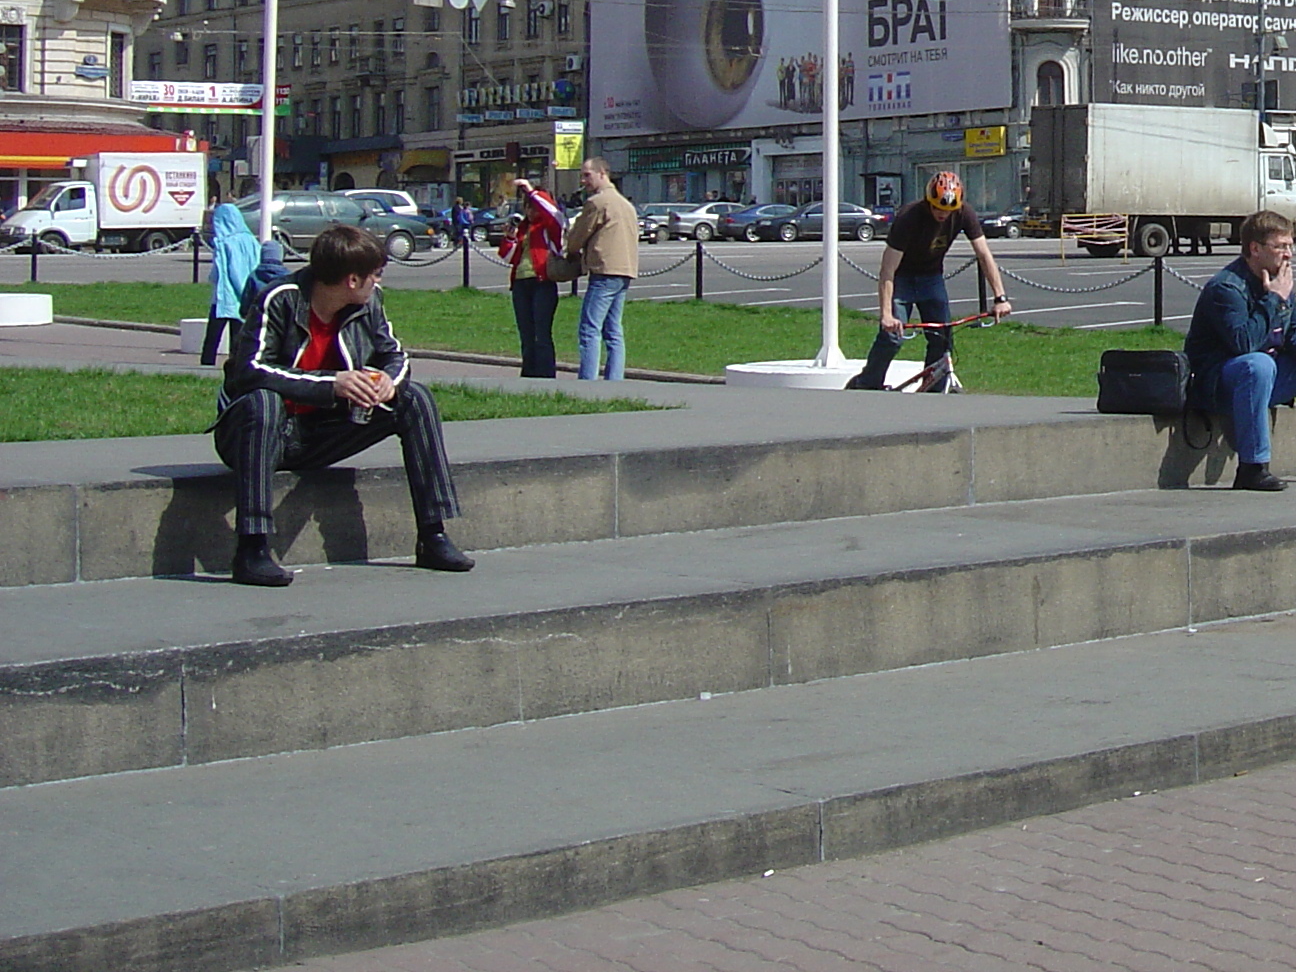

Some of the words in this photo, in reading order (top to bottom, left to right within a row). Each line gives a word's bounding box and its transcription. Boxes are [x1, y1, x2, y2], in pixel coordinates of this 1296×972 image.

[1111, 2, 1192, 29] Режиссер,
[867, 51, 908, 68] СМОТРИТ
[910, 49, 923, 62] НА
[925, 47, 948, 61] ТЕБЯ
[164, 84, 175, 95] 30
[1135, 83, 1167, 95] никто
[1168, 83, 1205, 99] другой
[684, 150, 737, 166] ПЛАНЕТА
